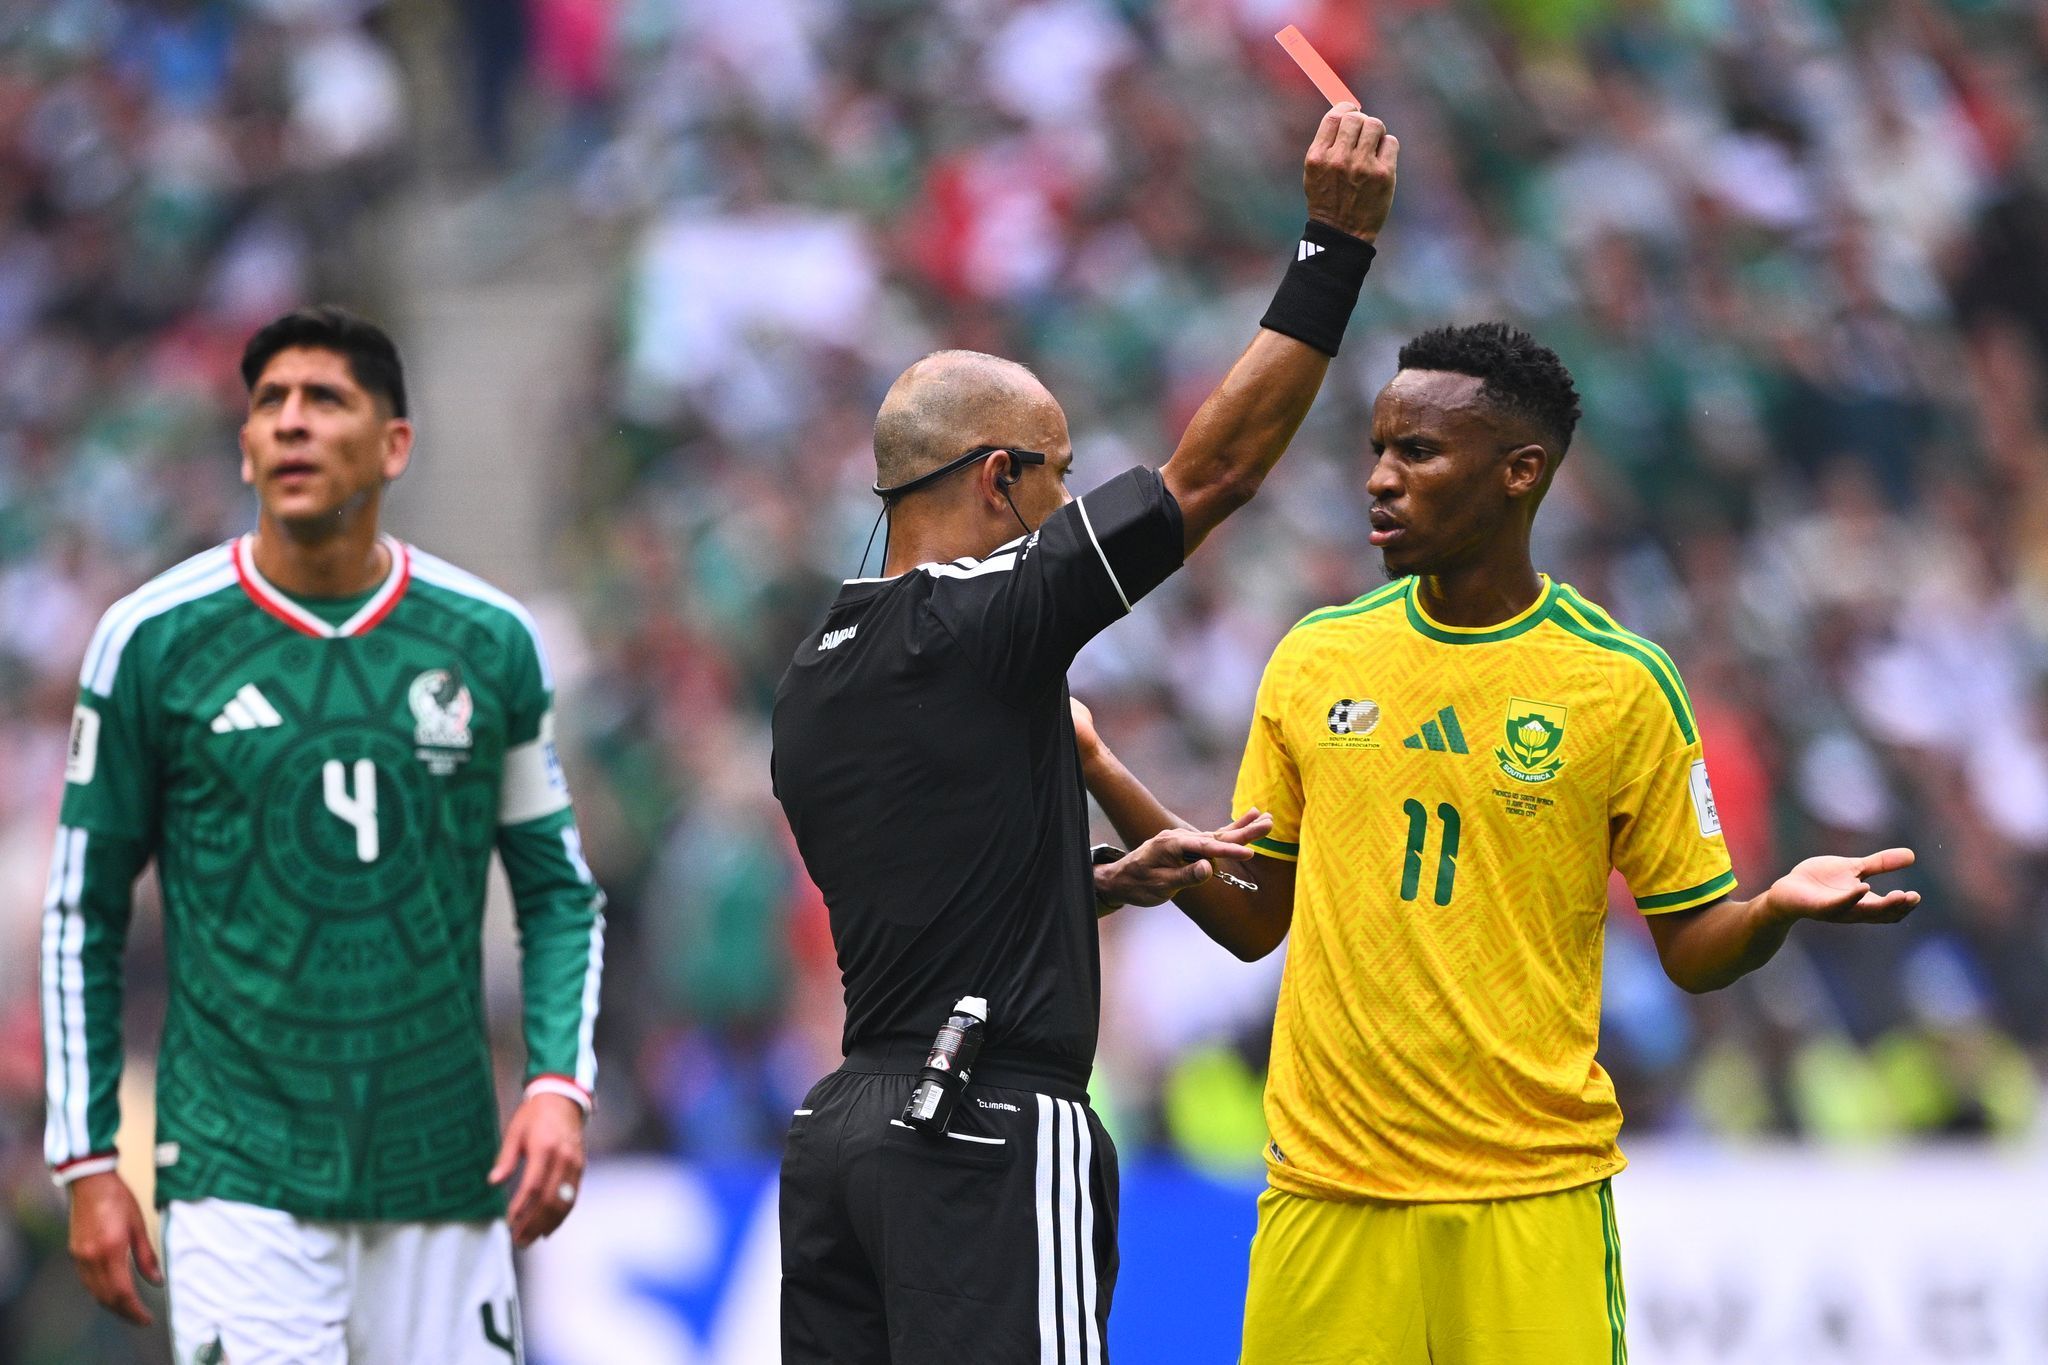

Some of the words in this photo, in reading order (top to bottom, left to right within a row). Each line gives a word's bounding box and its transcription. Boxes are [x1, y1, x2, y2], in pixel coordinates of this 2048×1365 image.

[323, 759, 379, 862] 4
[1503, 764, 1524, 779] SOUTH
[1525, 773, 1551, 781] AFRICA
[1400, 798, 1461, 906] 11
